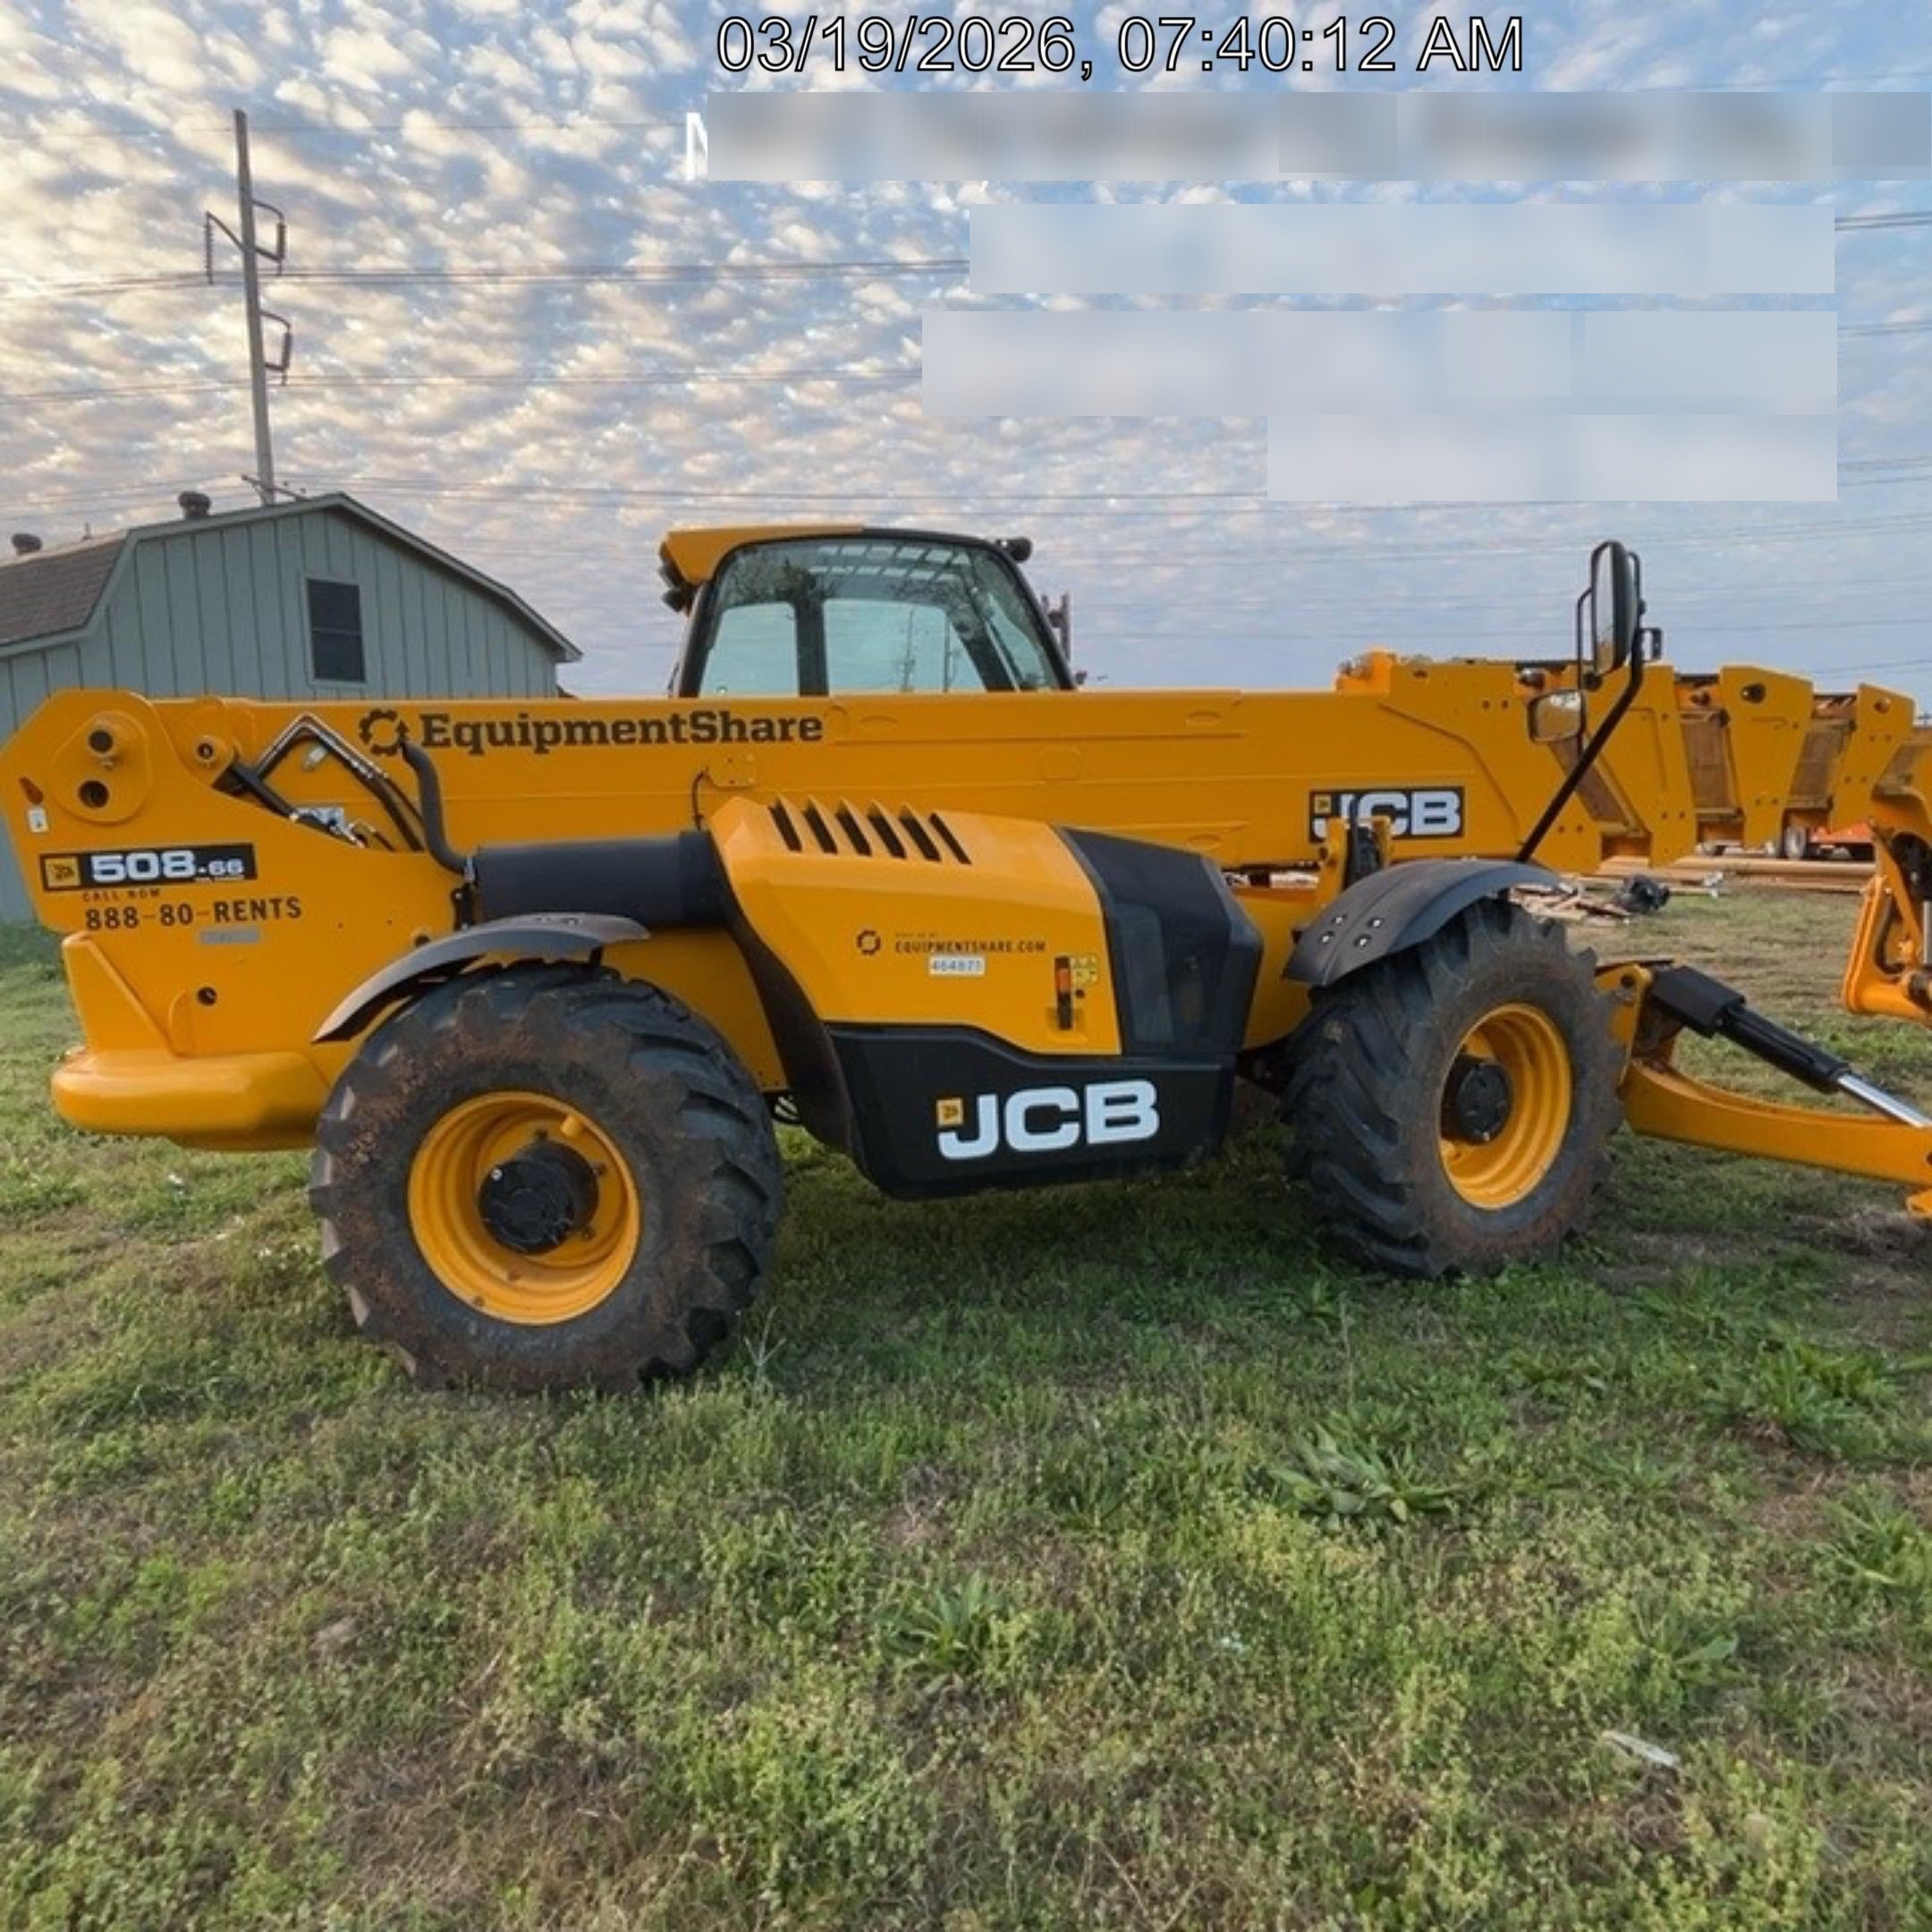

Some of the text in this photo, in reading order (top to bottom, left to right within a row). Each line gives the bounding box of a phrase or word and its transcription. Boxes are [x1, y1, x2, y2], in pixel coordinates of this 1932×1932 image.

[421, 711, 822, 754] EquipmentShare
[86, 896, 301, 931] 888-80-RENTS
[937, 1080, 1160, 1160] JCB
